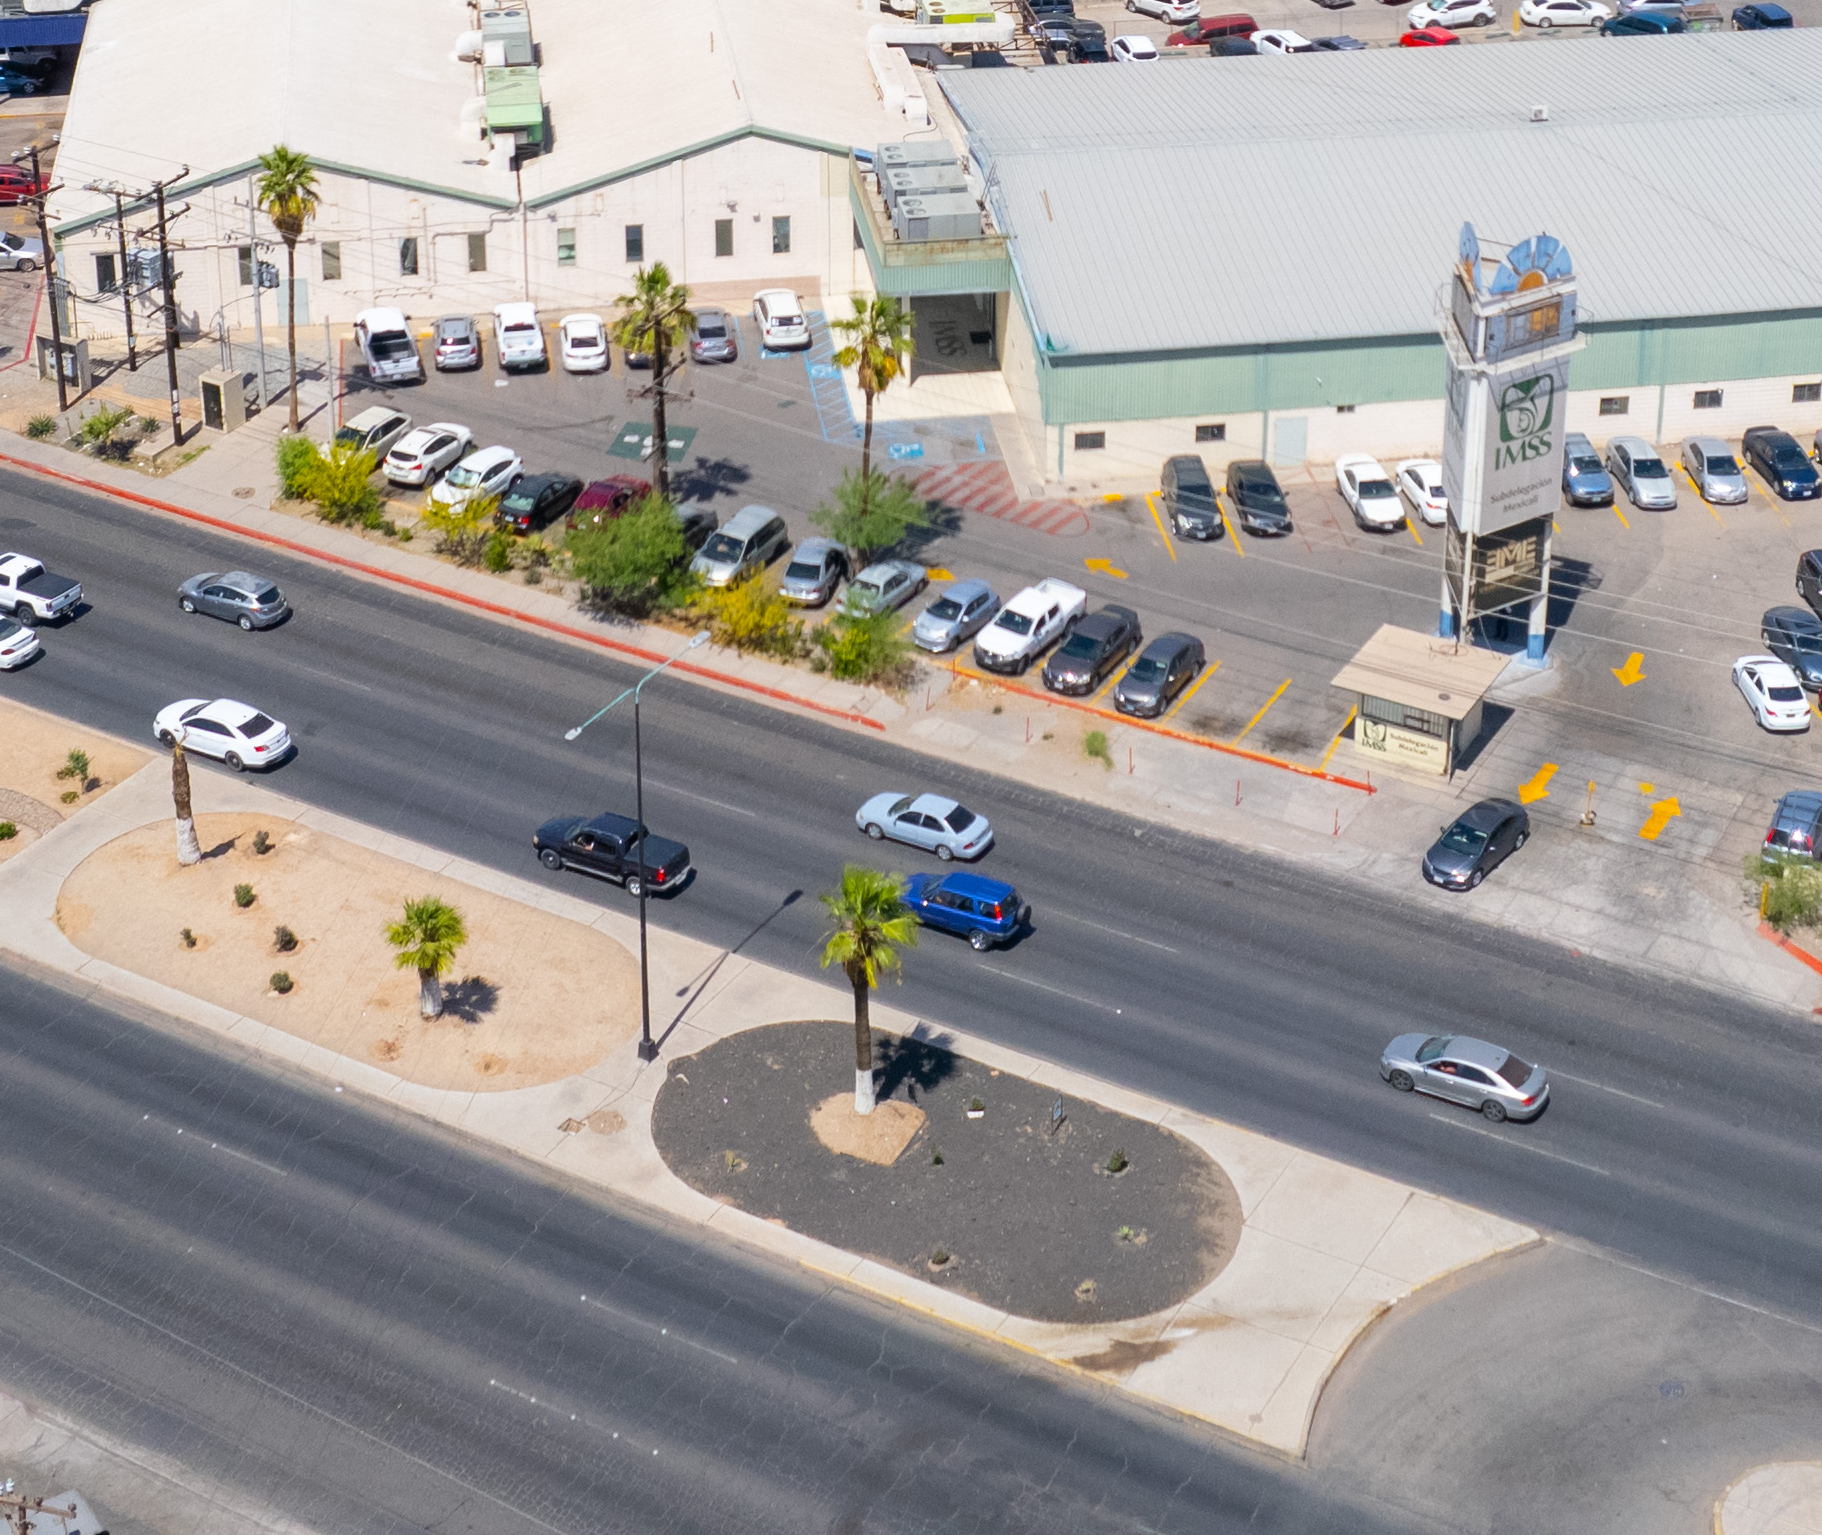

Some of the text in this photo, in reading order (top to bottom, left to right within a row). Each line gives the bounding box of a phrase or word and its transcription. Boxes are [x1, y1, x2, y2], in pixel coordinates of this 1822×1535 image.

[1494, 431, 1553, 472] IMSS
[1490, 476, 1553, 505] Subdelegación
[1501, 493, 1540, 514] Mexicali
[1361, 738, 1387, 752] IMSS
